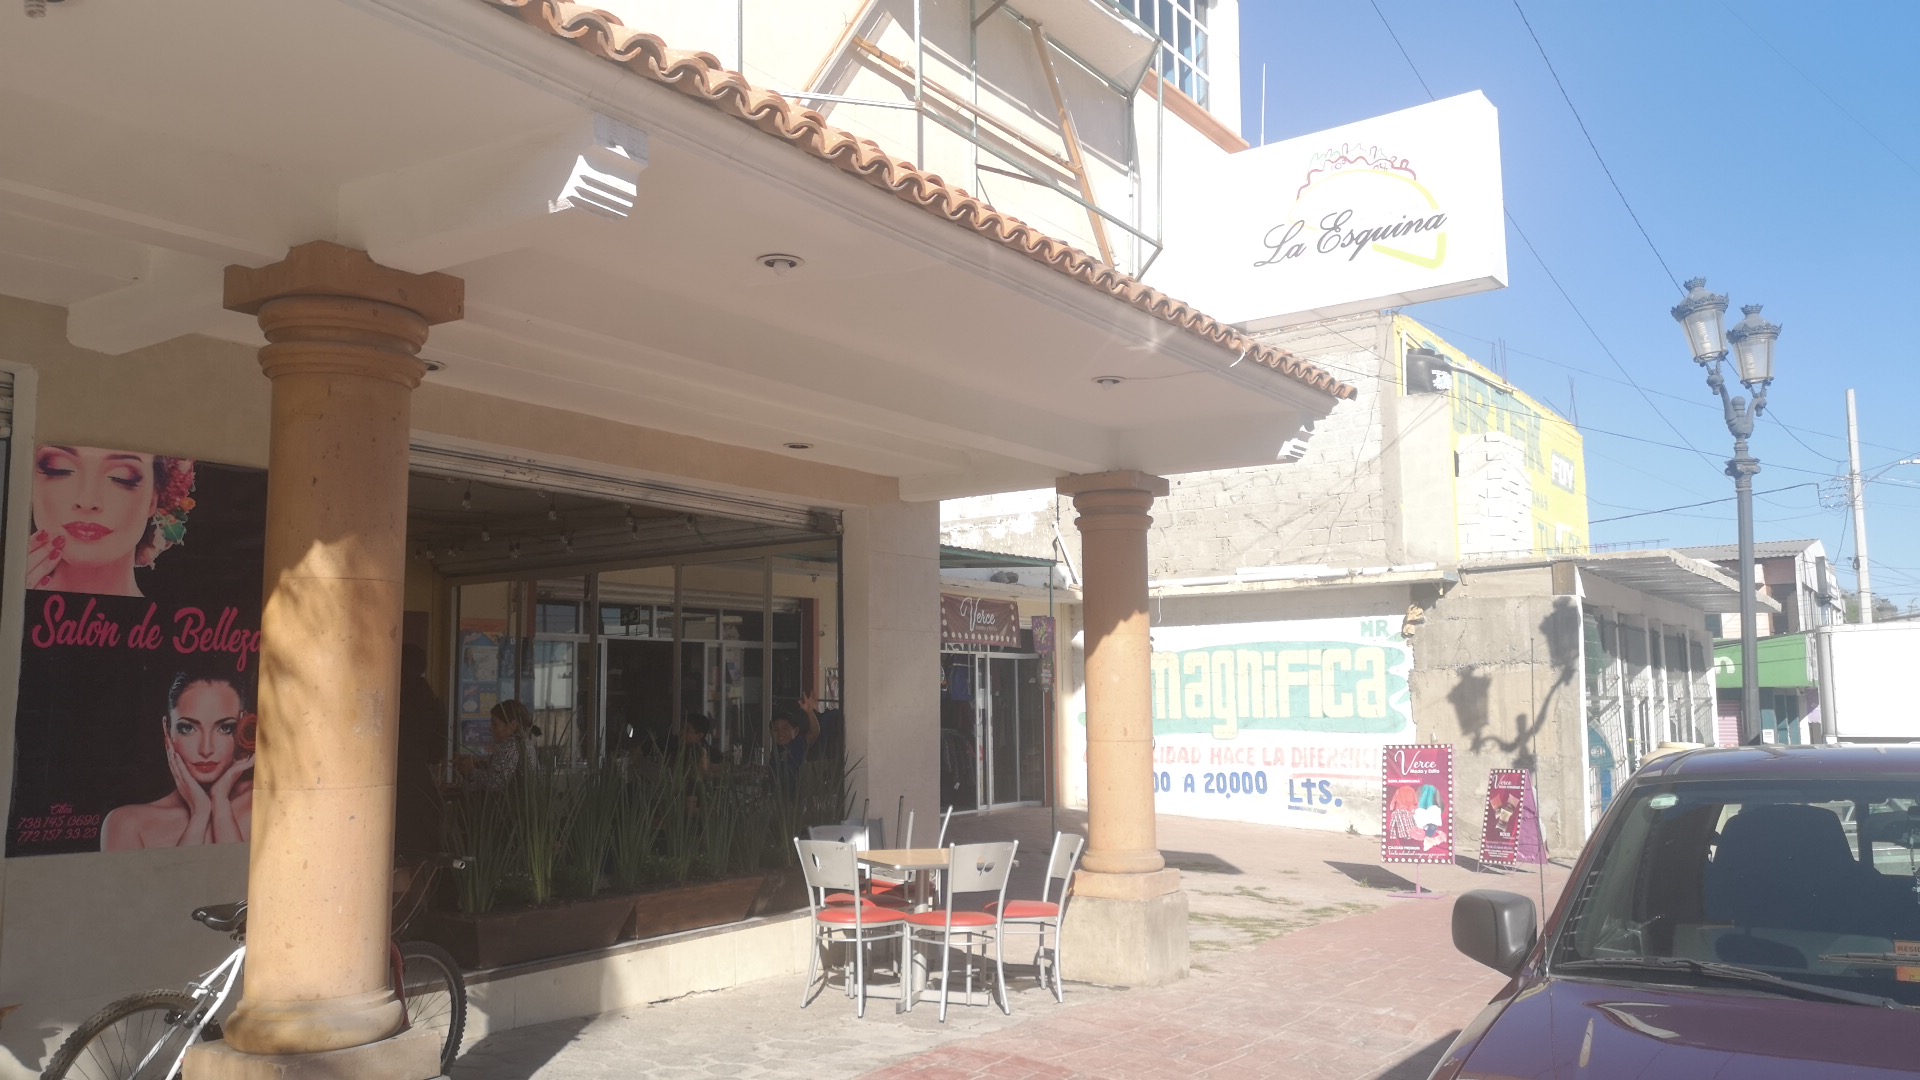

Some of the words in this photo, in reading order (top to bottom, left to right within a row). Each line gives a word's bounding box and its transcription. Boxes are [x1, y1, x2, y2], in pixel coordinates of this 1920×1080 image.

[1253, 219, 1307, 267] La
[1316, 208, 1447, 262] Esquina
[32, 594, 121, 649] Salón
[127, 602, 163, 650] de
[960, 597, 996, 632] Verce
[1360, 619, 1390, 638] MR
[1210, 746, 1256, 766] HACE
[1262, 746, 1285, 766] LA
[1394, 750, 1437, 776] Verce
[1184, 773, 1196, 792] A
